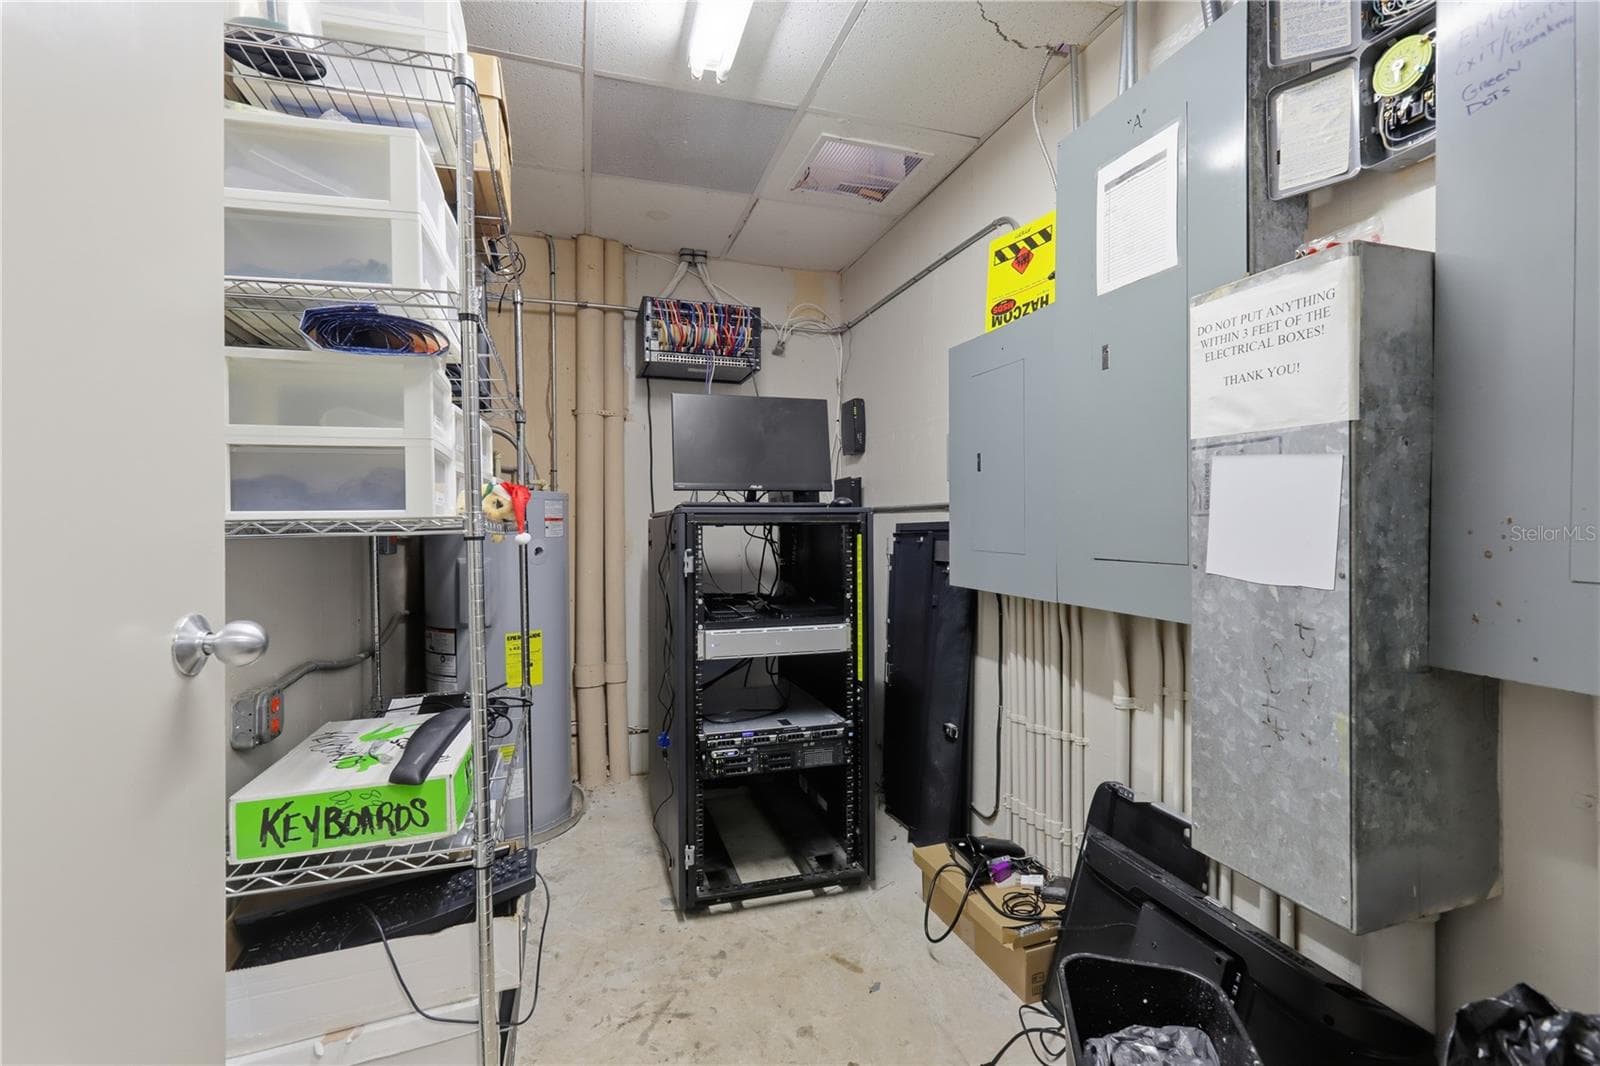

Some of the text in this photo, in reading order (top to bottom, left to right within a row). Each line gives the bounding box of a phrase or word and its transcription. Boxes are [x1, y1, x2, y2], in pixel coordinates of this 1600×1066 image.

[1465, 86, 1511, 116] DOTS
[992, 294, 1049, 328] HAZCOM
[1197, 288, 1336, 337] DO NOT PUT ANYTHING
[1200, 305, 1332, 349] WITHIN 3 FEET OF THE
[1204, 324, 1326, 362] ELECTRICAL BOXES!
[1223, 362, 1301, 386] THANK YOU!
[260, 797, 430, 848] KEYBOARDS
